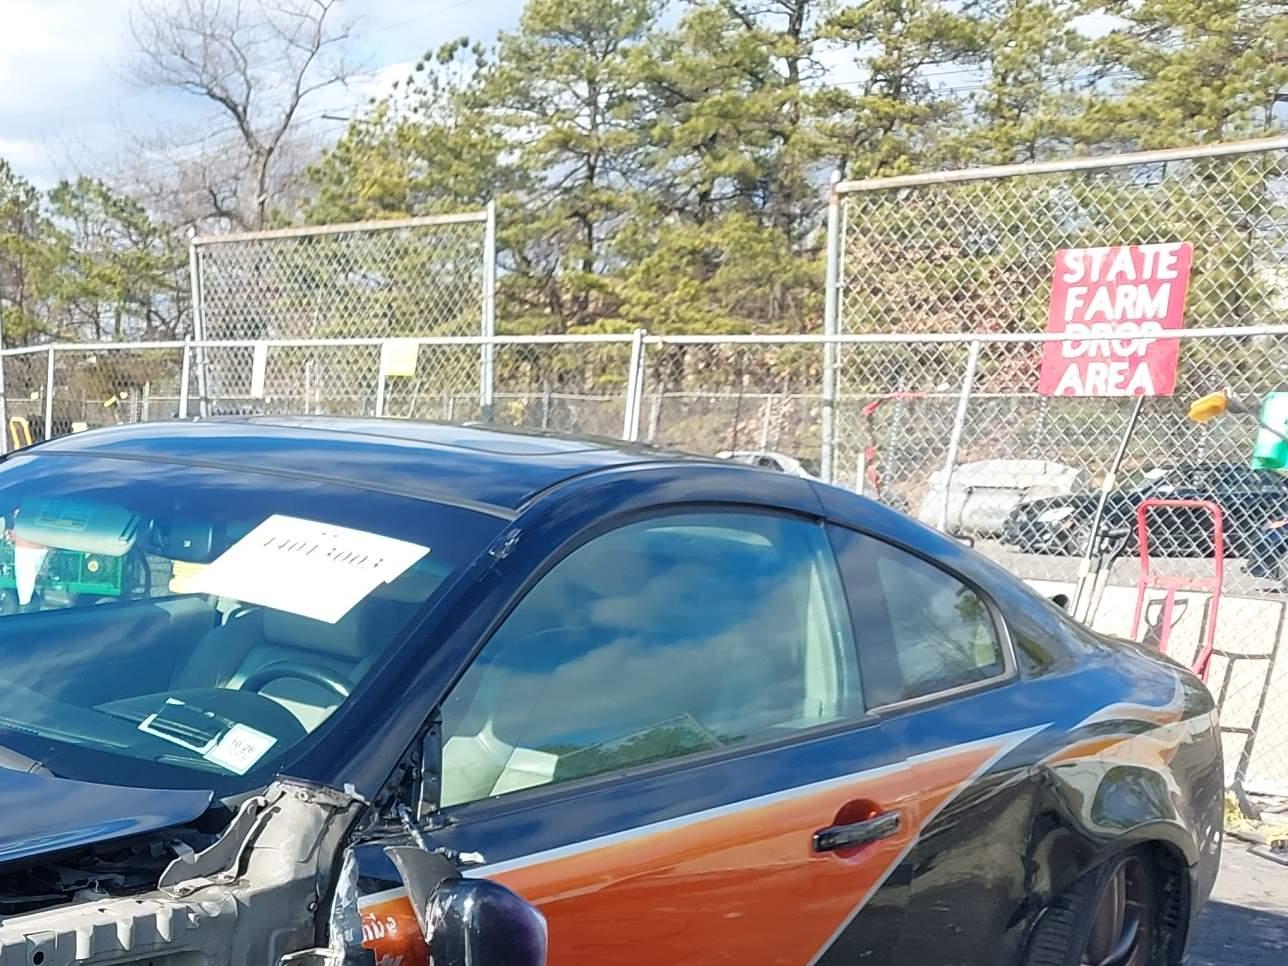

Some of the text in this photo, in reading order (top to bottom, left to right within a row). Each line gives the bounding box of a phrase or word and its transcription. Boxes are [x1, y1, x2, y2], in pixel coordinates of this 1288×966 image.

[1063, 242, 1182, 283] STATE
[1064, 284, 1171, 321] FARM
[1062, 322, 1162, 358] DROP
[1054, 361, 1155, 396] AREA
